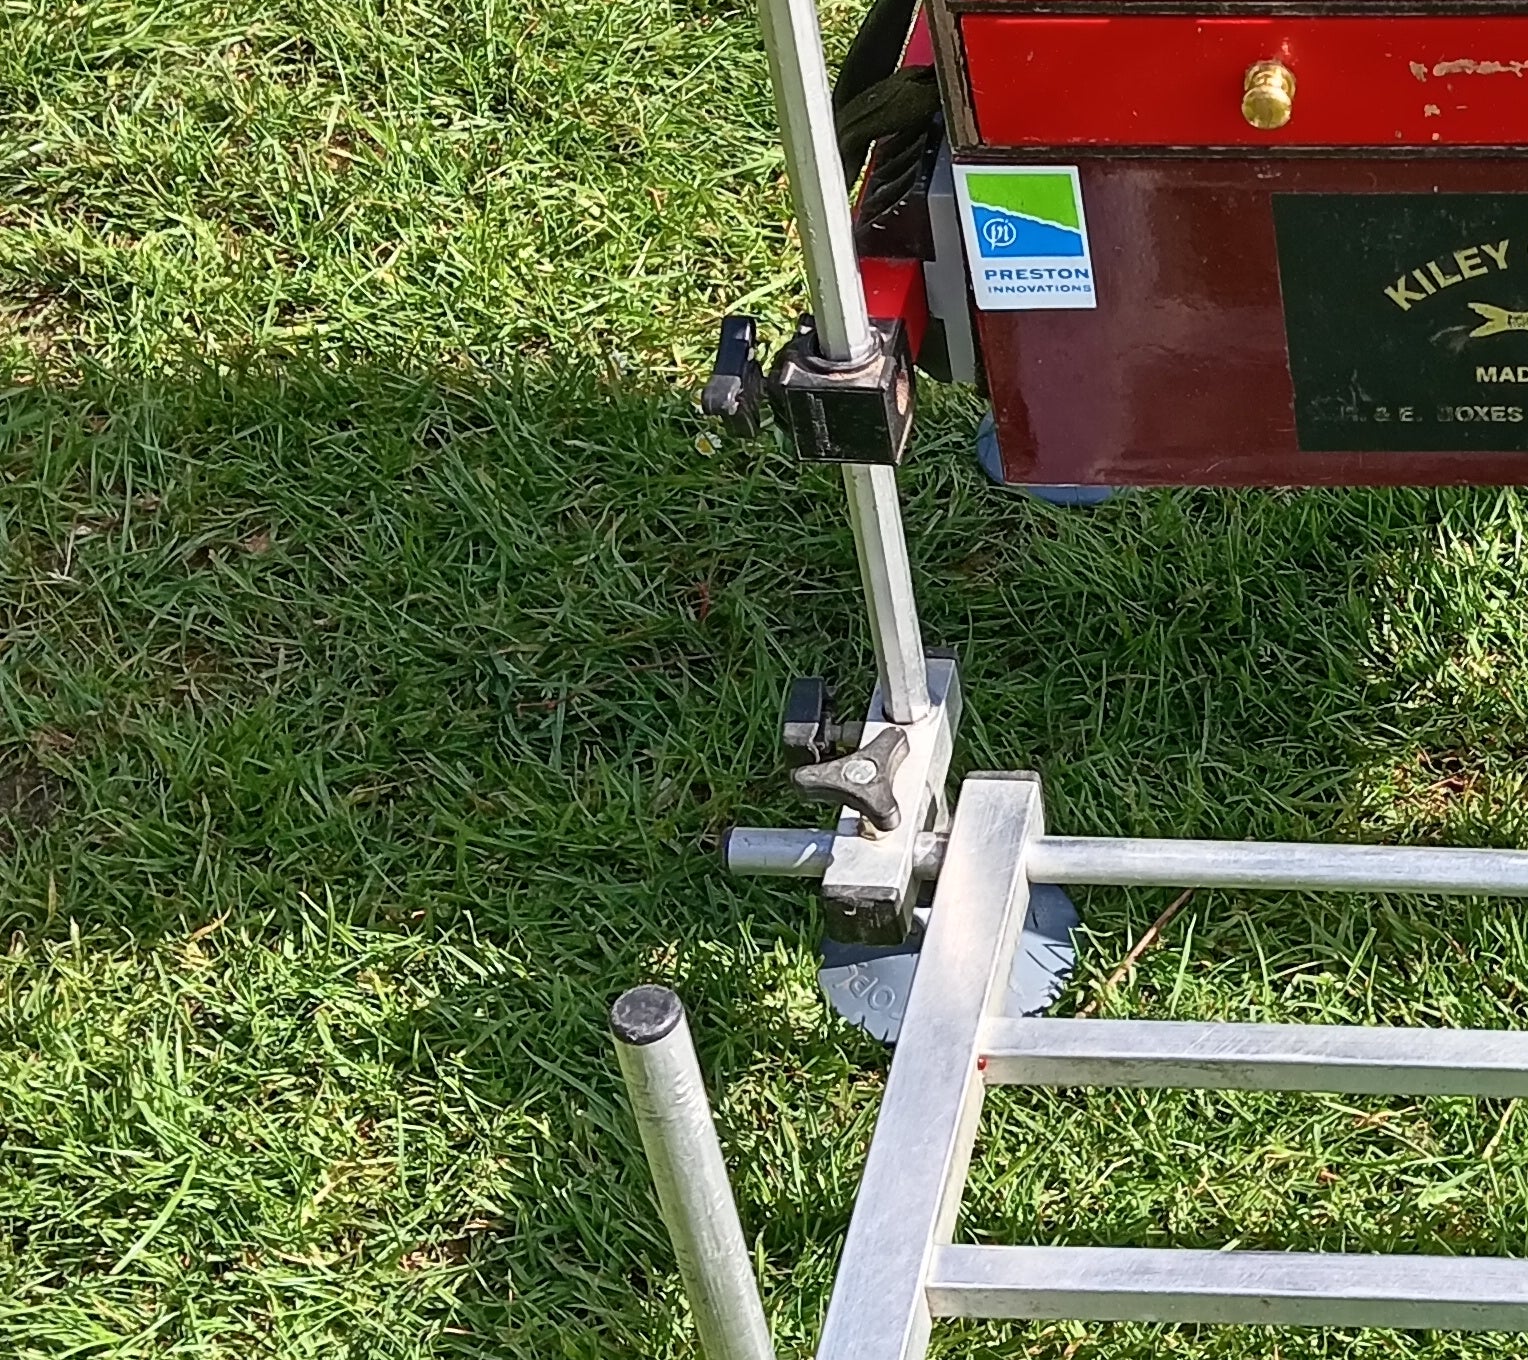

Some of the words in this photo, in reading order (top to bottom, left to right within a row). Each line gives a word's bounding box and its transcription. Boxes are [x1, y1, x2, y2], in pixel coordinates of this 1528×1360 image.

[985, 268, 1090, 281] PRESTON
[1384, 240, 1511, 311] KILEY
[988, 284, 1092, 294] INNOVATIONS
